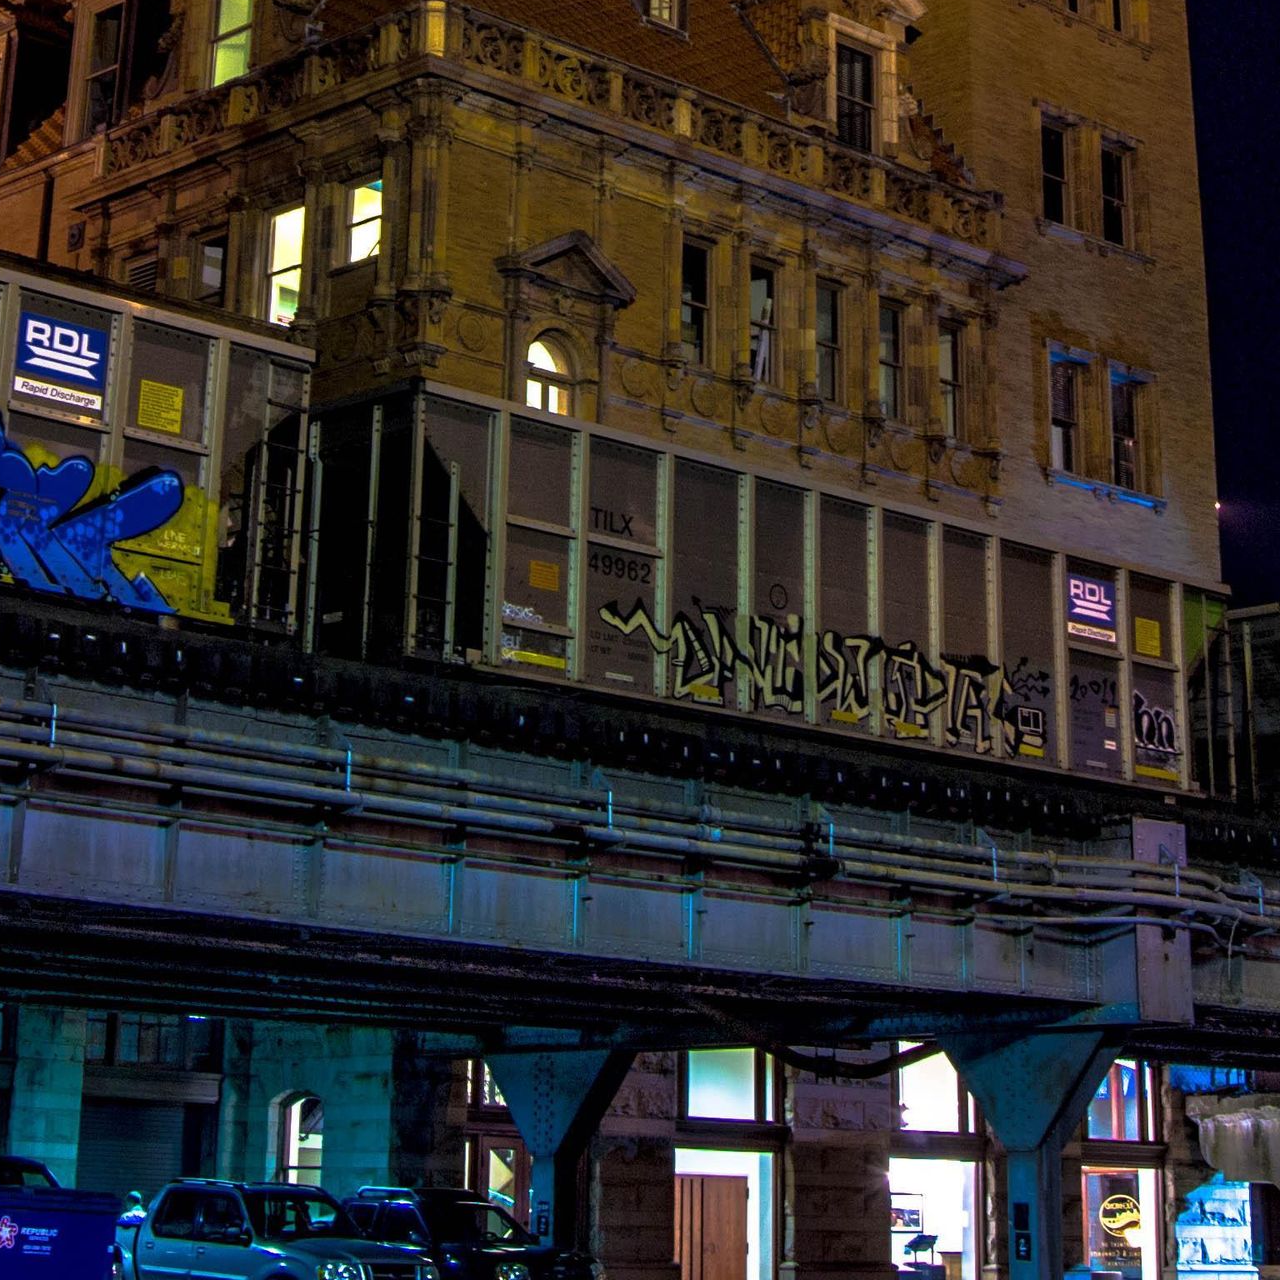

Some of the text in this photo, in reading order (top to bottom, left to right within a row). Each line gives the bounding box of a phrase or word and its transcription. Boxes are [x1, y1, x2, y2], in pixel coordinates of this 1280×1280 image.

[25, 319, 100, 360] RDL
[21, 380, 96, 407] Rapid Discharge
[591, 507, 634, 537] TILX
[589, 552, 651, 585] 49962
[1070, 578, 1112, 606] RDL
